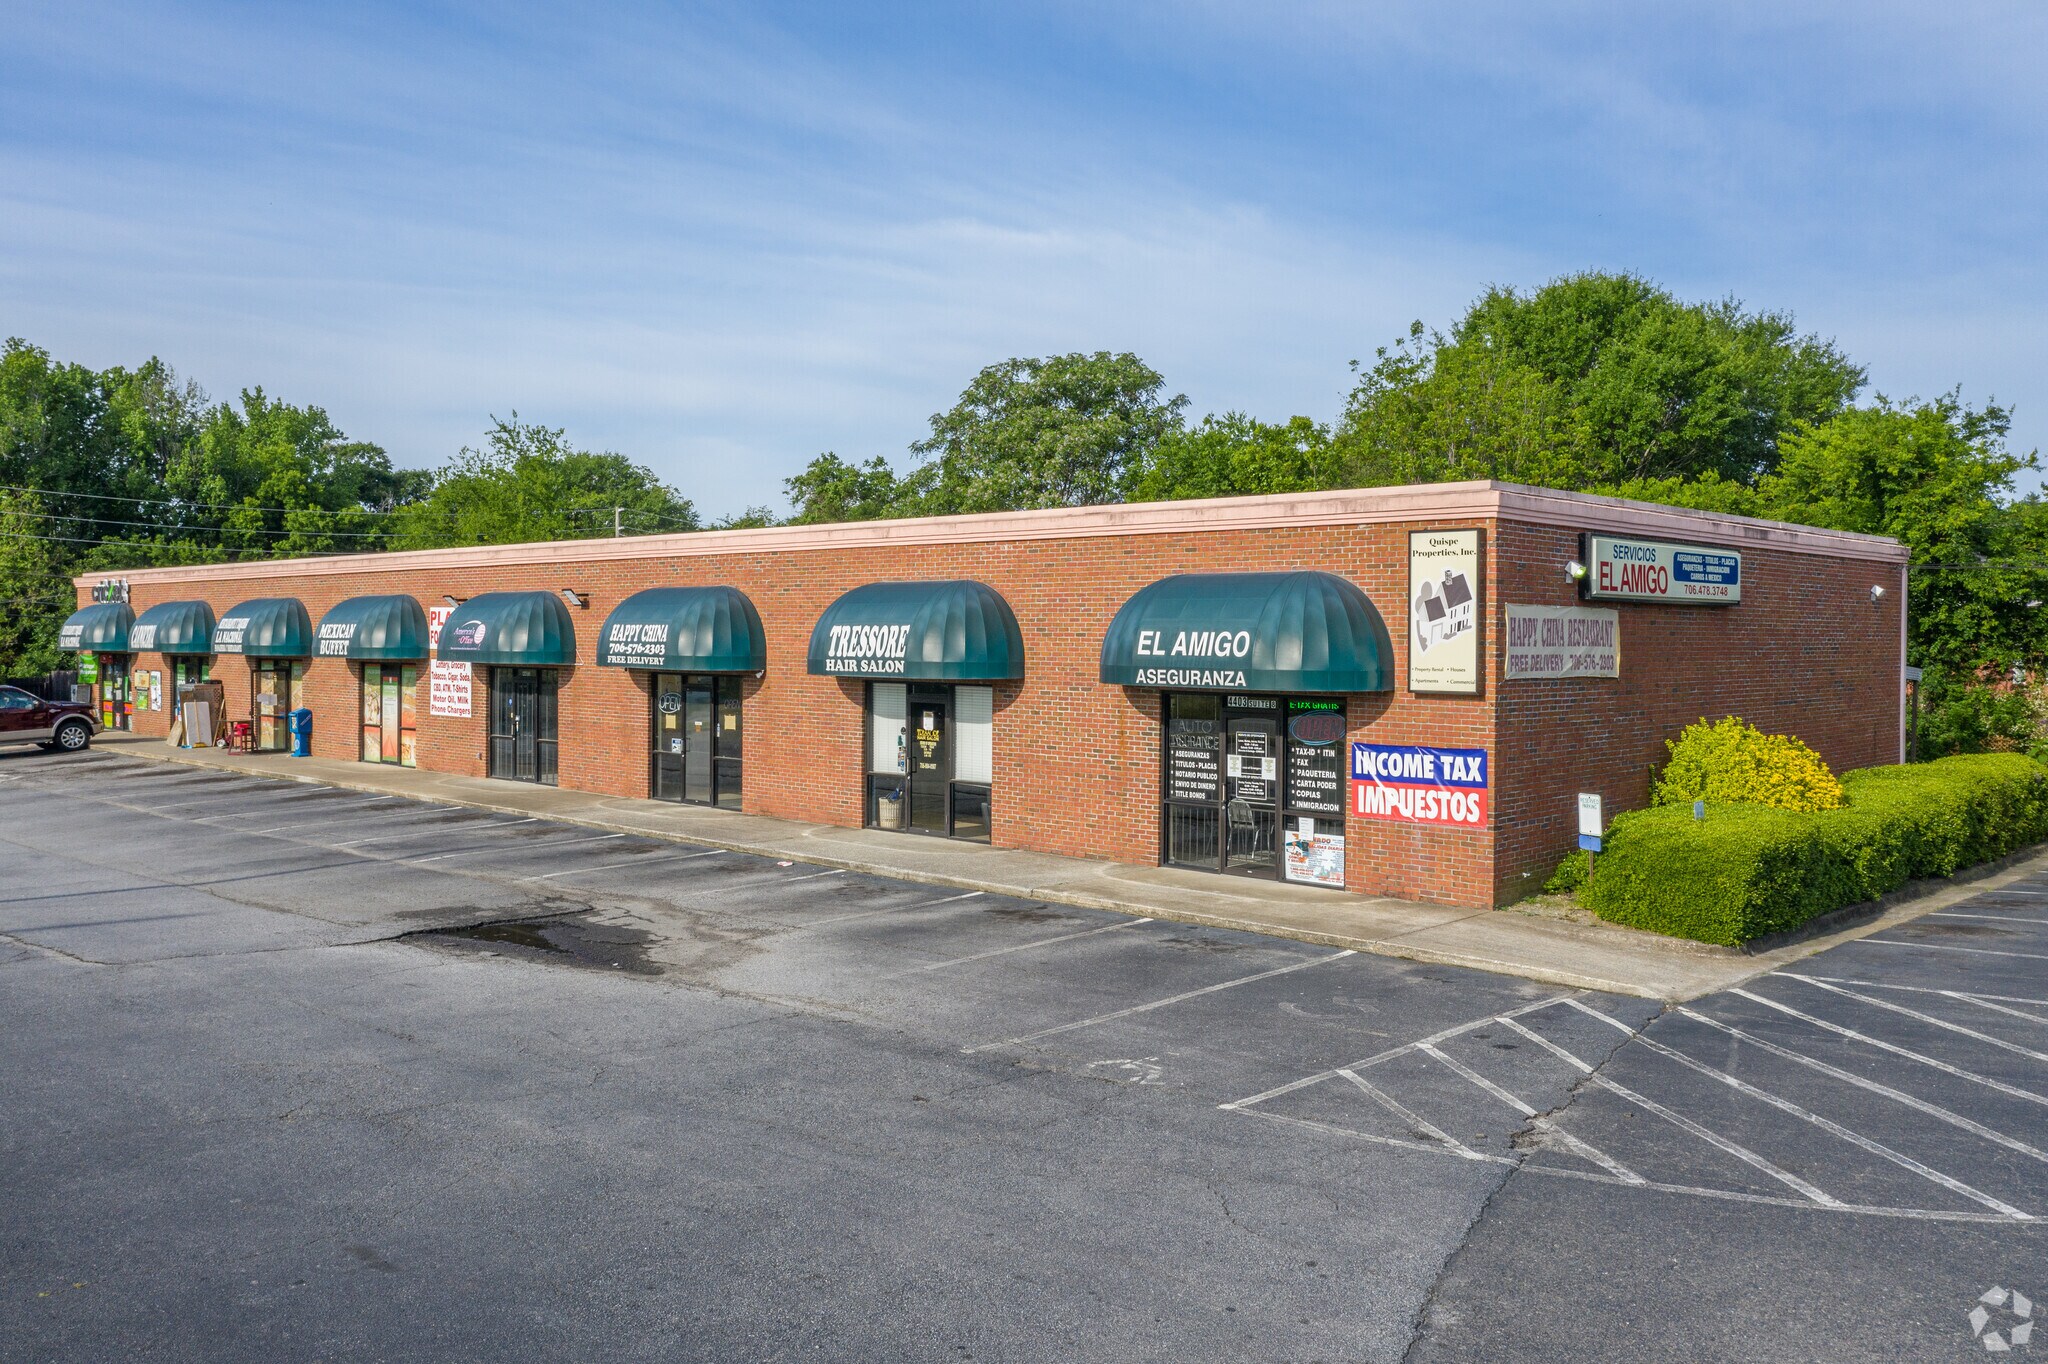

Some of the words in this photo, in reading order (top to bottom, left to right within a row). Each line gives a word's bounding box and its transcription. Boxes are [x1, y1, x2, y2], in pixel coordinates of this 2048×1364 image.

[1429, 538, 1458, 547] Quispe
[1461, 548, 1476, 556] Inc.
[1613, 544, 1656, 562] SERVICIOS
[1721, 558, 1735, 566] PLACAS
[1600, 561, 1618, 592] EL
[1620, 563, 1668, 594] AMIGO
[1684, 585, 1728, 596] 706.478.3748
[318, 624, 356, 639] MEXICAN
[610, 624, 642, 642] HAPPY
[641, 624, 668, 642] CHINA
[1510, 617, 1538, 647] HAPPY
[1542, 618, 1565, 647] CHINA
[1568, 619, 1613, 647] RESTAURANT
[828, 624, 910, 658] TRESSORE
[1137, 630, 1166, 656] EL
[1170, 630, 1250, 658] AMIGO
[320, 640, 349, 655] BUFFET
[609, 643, 665, 655] 706-576-2303
[451, 661, 466, 671] Grocery
[607, 655, 626, 664] FREE
[627, 656, 664, 665] DELIVERY
[826, 659, 858, 672] HAIR
[860, 660, 904, 673] SALON
[1510, 654, 1528, 672] FREE
[1530, 654, 1564, 672] DELIVERY
[1136, 669, 1247, 687] ASEGURANZA
[453, 684, 468, 693] T-Shirts
[458, 696, 468, 704] Milk
[660, 696, 680, 710] OPEN
[1228, 696, 1247, 708] 4403
[1248, 700, 1269, 708] SUITE
[432, 704, 446, 712] Phone
[447, 706, 470, 716] Chargers
[1179, 720, 1212, 733] AUTO
[1296, 717, 1342, 740] OPEN
[1175, 751, 1209, 759] ASEGURANZAS
[1355, 750, 1434, 780] INCOME
[1440, 756, 1482, 783] TAX
[1297, 769, 1336, 779] PAQUETERIA
[1297, 780, 1316, 788] CARTA
[1317, 781, 1336, 789] PODER
[1296, 790, 1320, 798] COPIAS
[1296, 800, 1339, 811] INMIGRACION
[1357, 784, 1480, 824] IMPUESTOS
